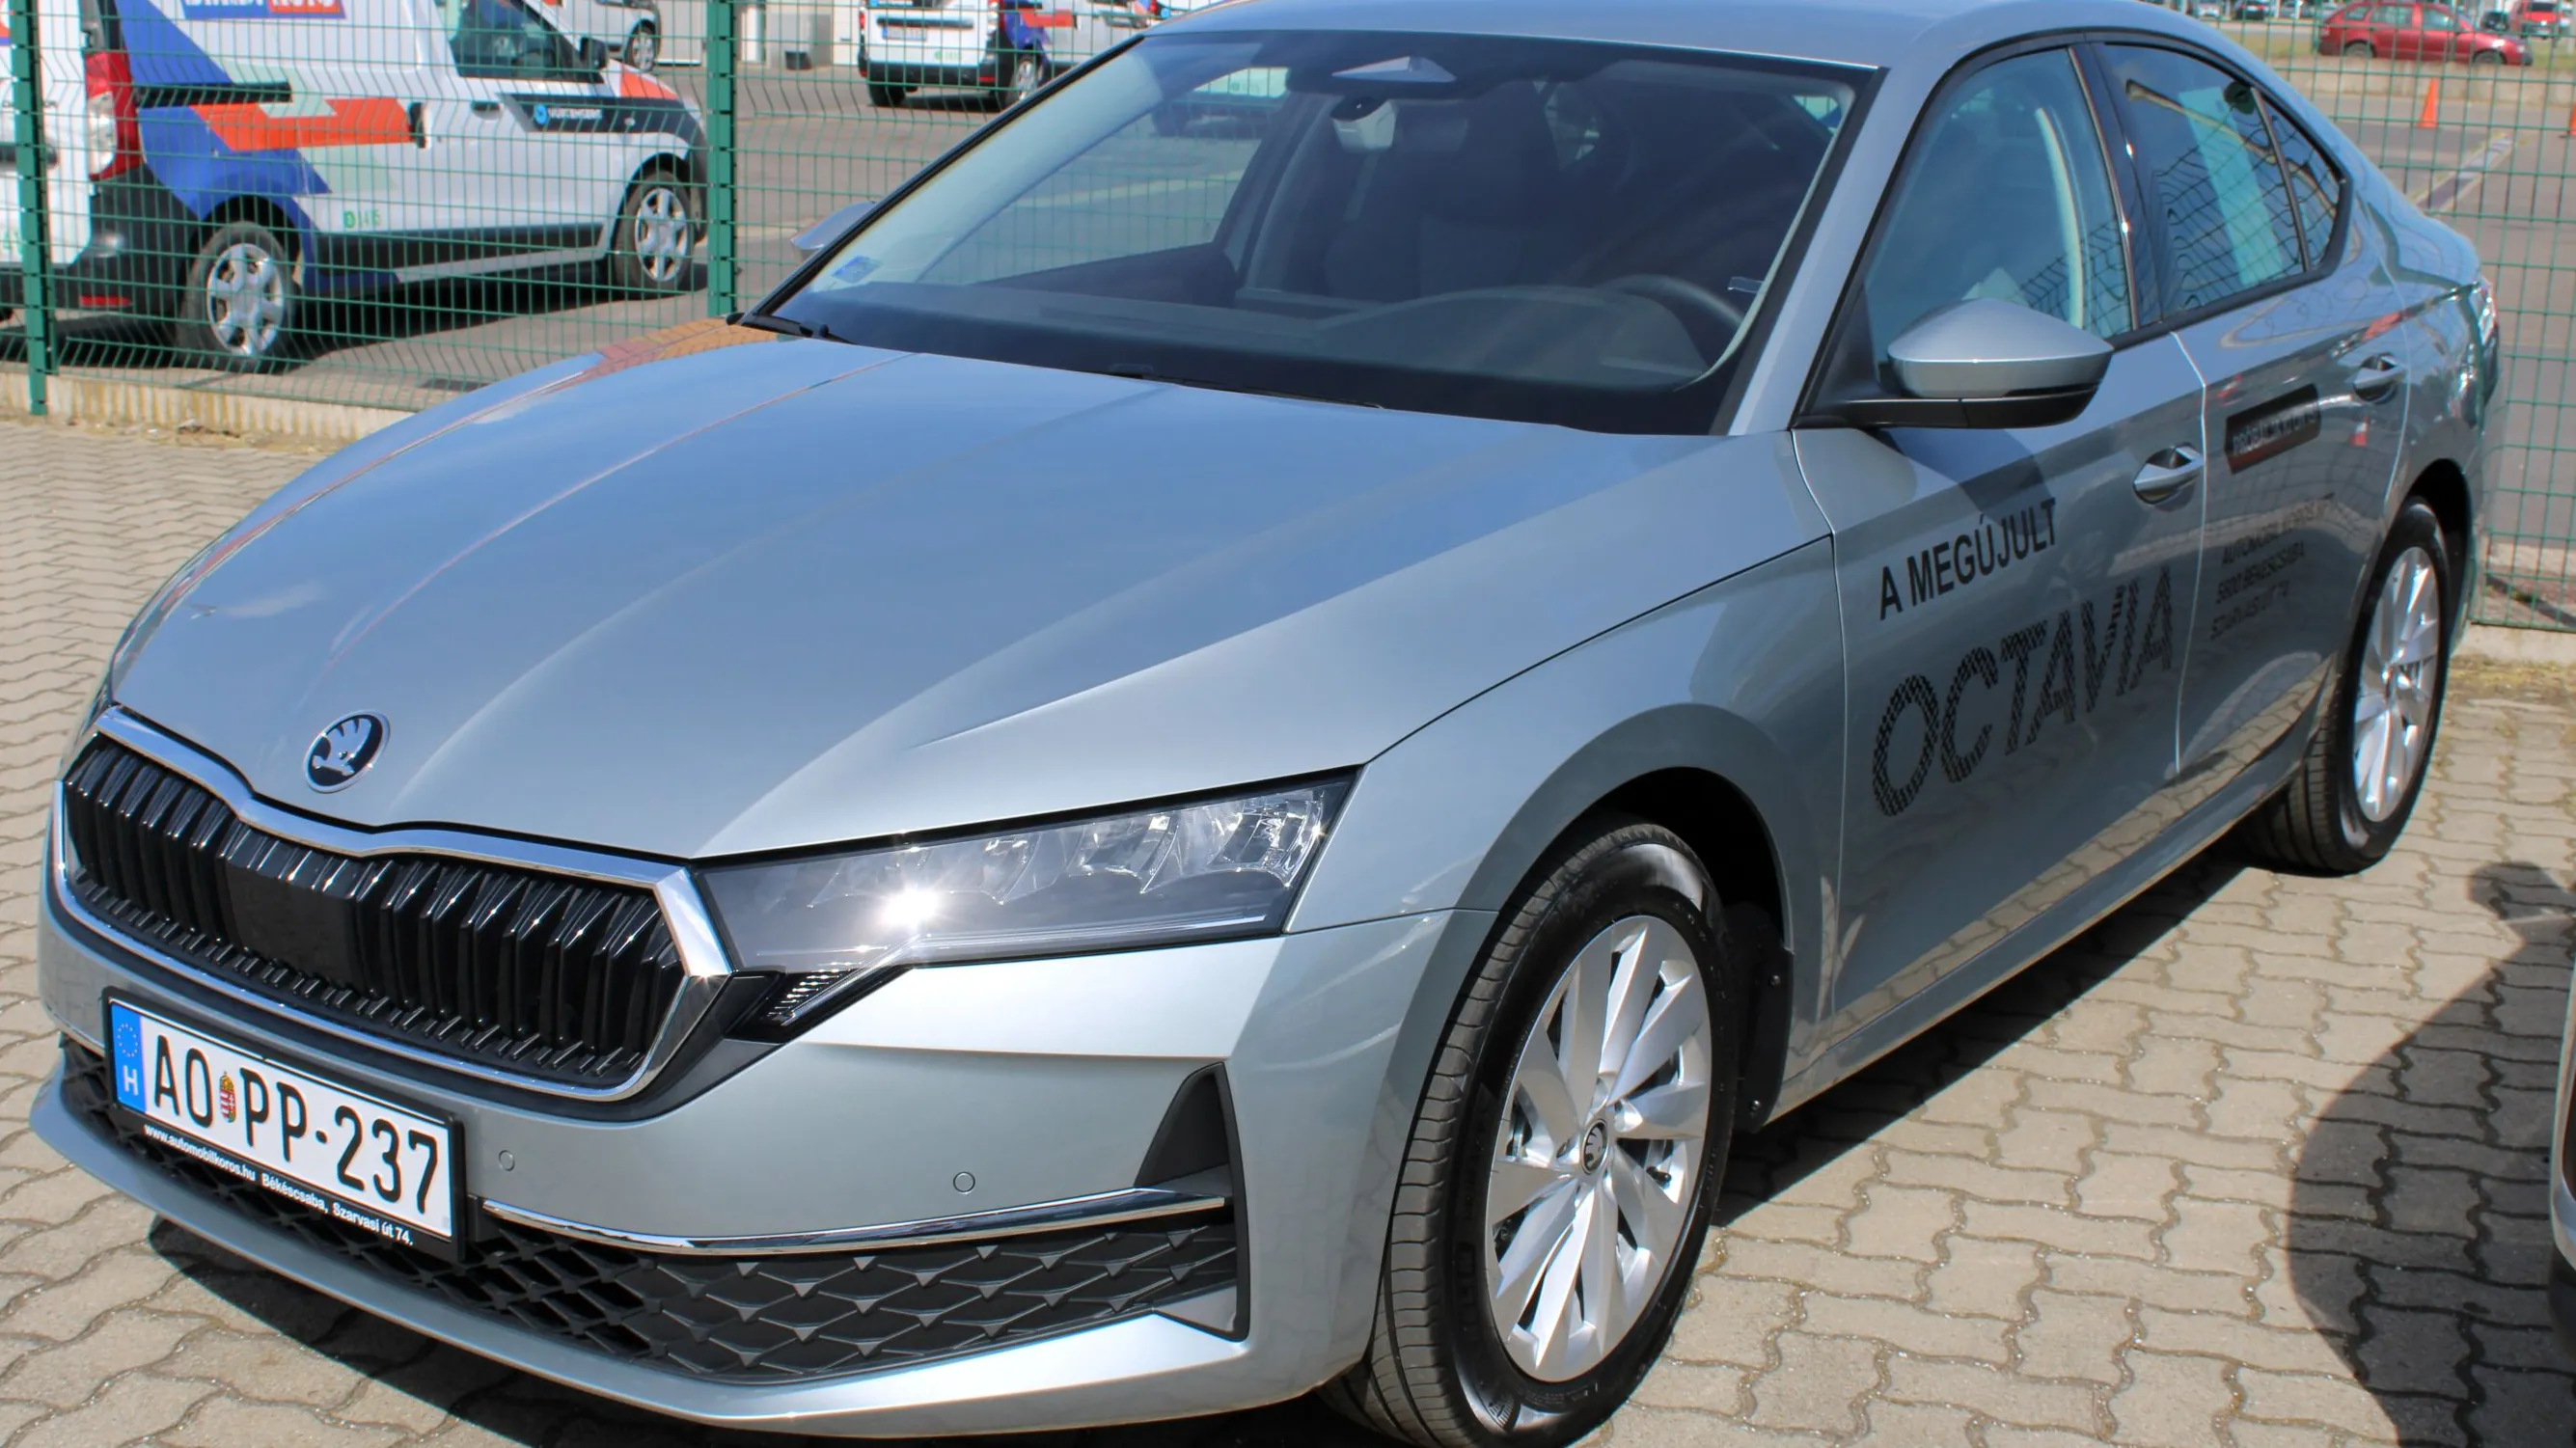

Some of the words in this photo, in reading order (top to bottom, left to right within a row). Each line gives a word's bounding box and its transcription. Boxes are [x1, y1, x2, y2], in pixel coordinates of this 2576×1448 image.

[1879, 565, 1903, 621] A
[1906, 496, 2056, 607] MEGÚJULT
[1872, 565, 2173, 816] OCTAVIA
[123, 1064, 139, 1096] H
[153, 1034, 213, 1130] AO
[241, 1066, 439, 1214] PP-237
[144, 1124, 257, 1182] www.automobilkoros.hu
[261, 1172, 329, 1215] Békéscsaba,
[333, 1202, 380, 1233] Szarvasi
[381, 1220, 394, 1239] út
[396, 1226, 414, 1246] 74.
